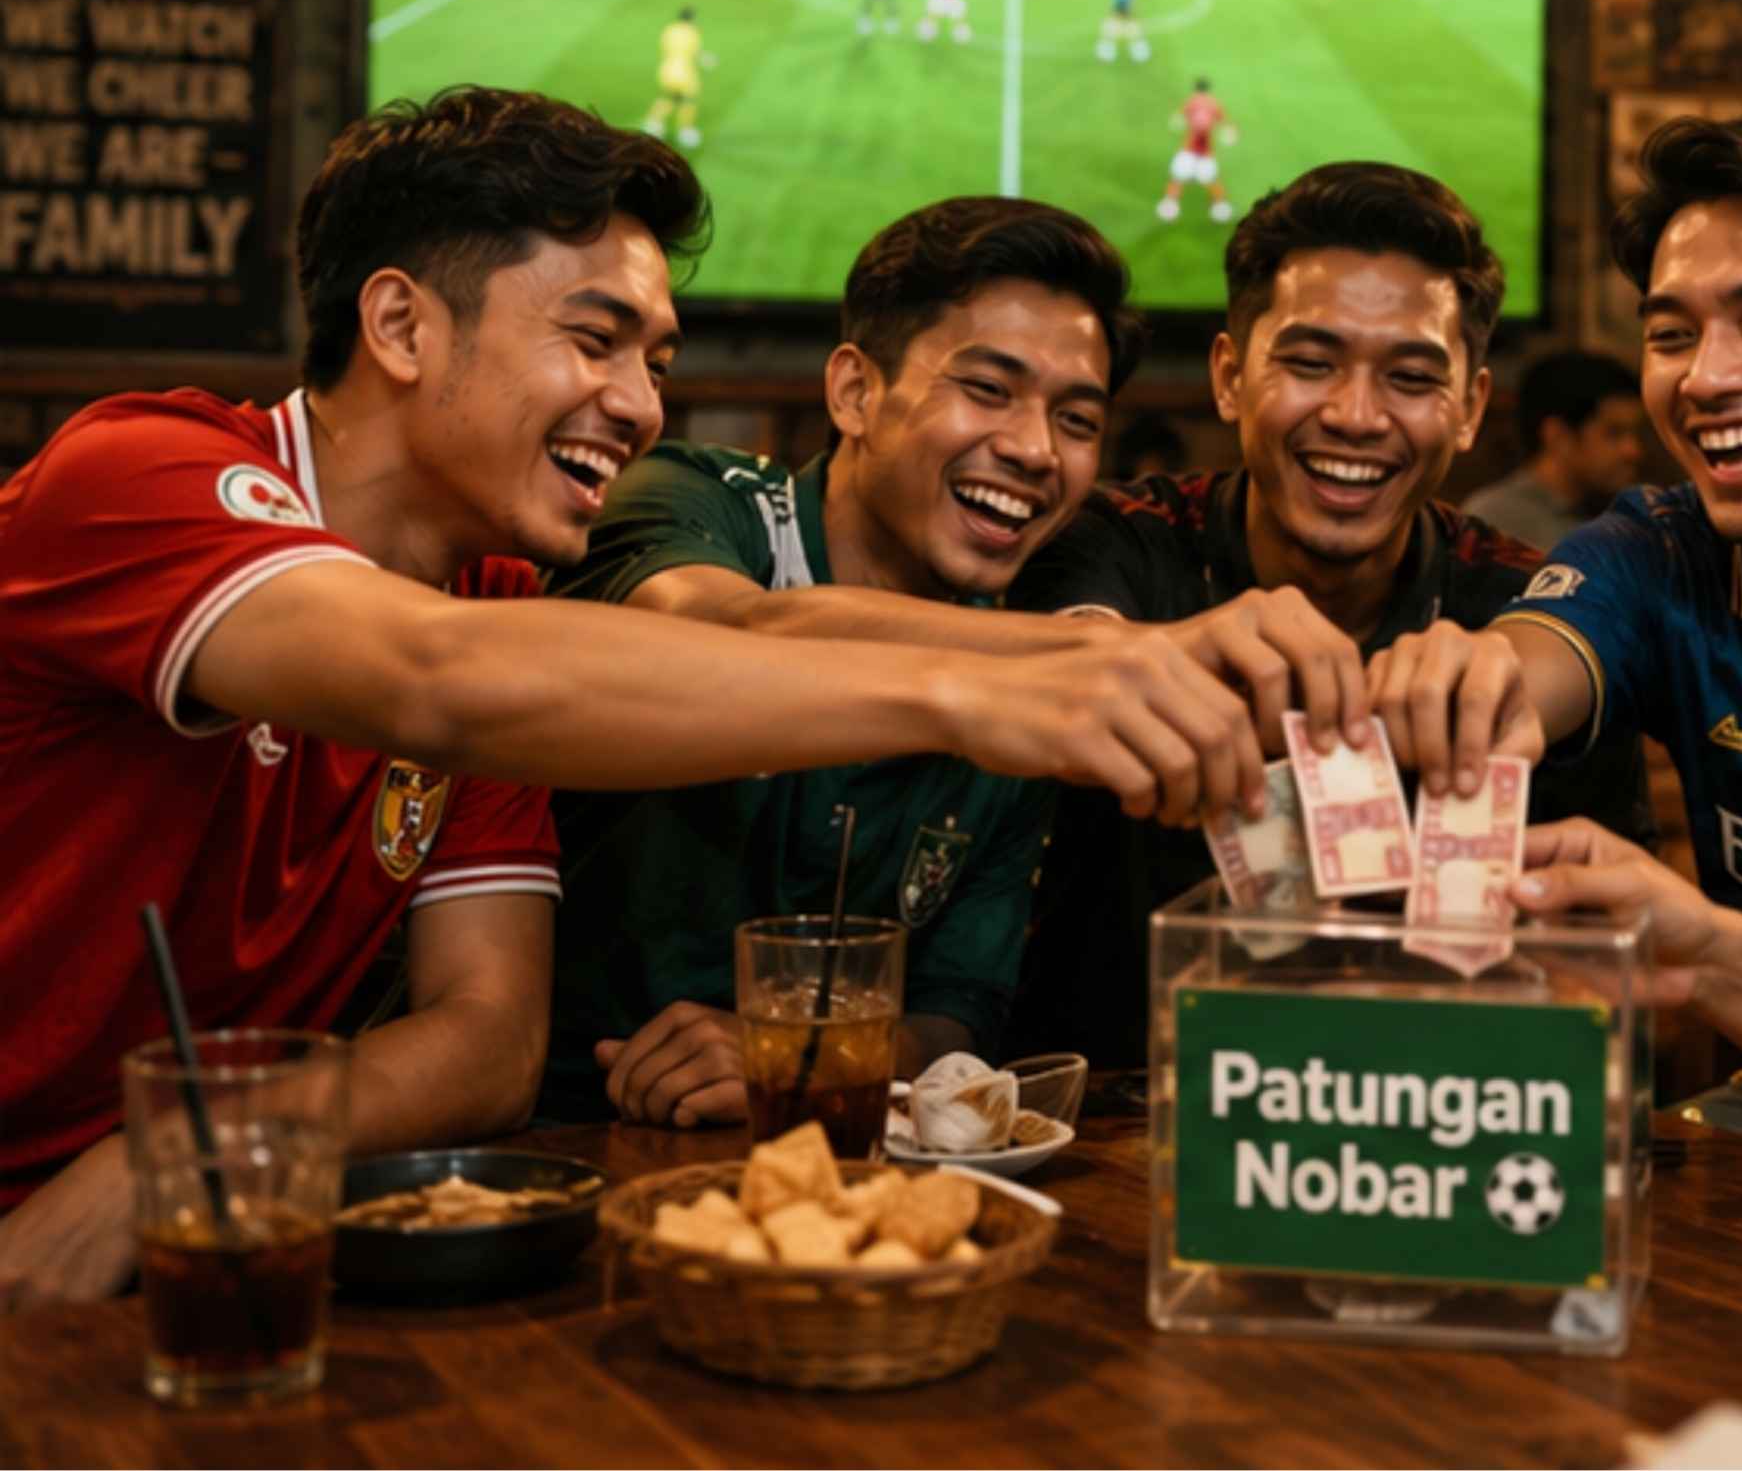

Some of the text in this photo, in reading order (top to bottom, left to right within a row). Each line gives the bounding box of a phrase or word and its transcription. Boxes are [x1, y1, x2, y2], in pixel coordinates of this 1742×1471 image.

[0, 121, 86, 179] WE
[0, 190, 251, 277] FAMILY
[1211, 1049, 1571, 1148] Patungan
[1234, 1139, 1468, 1220] Nobar
